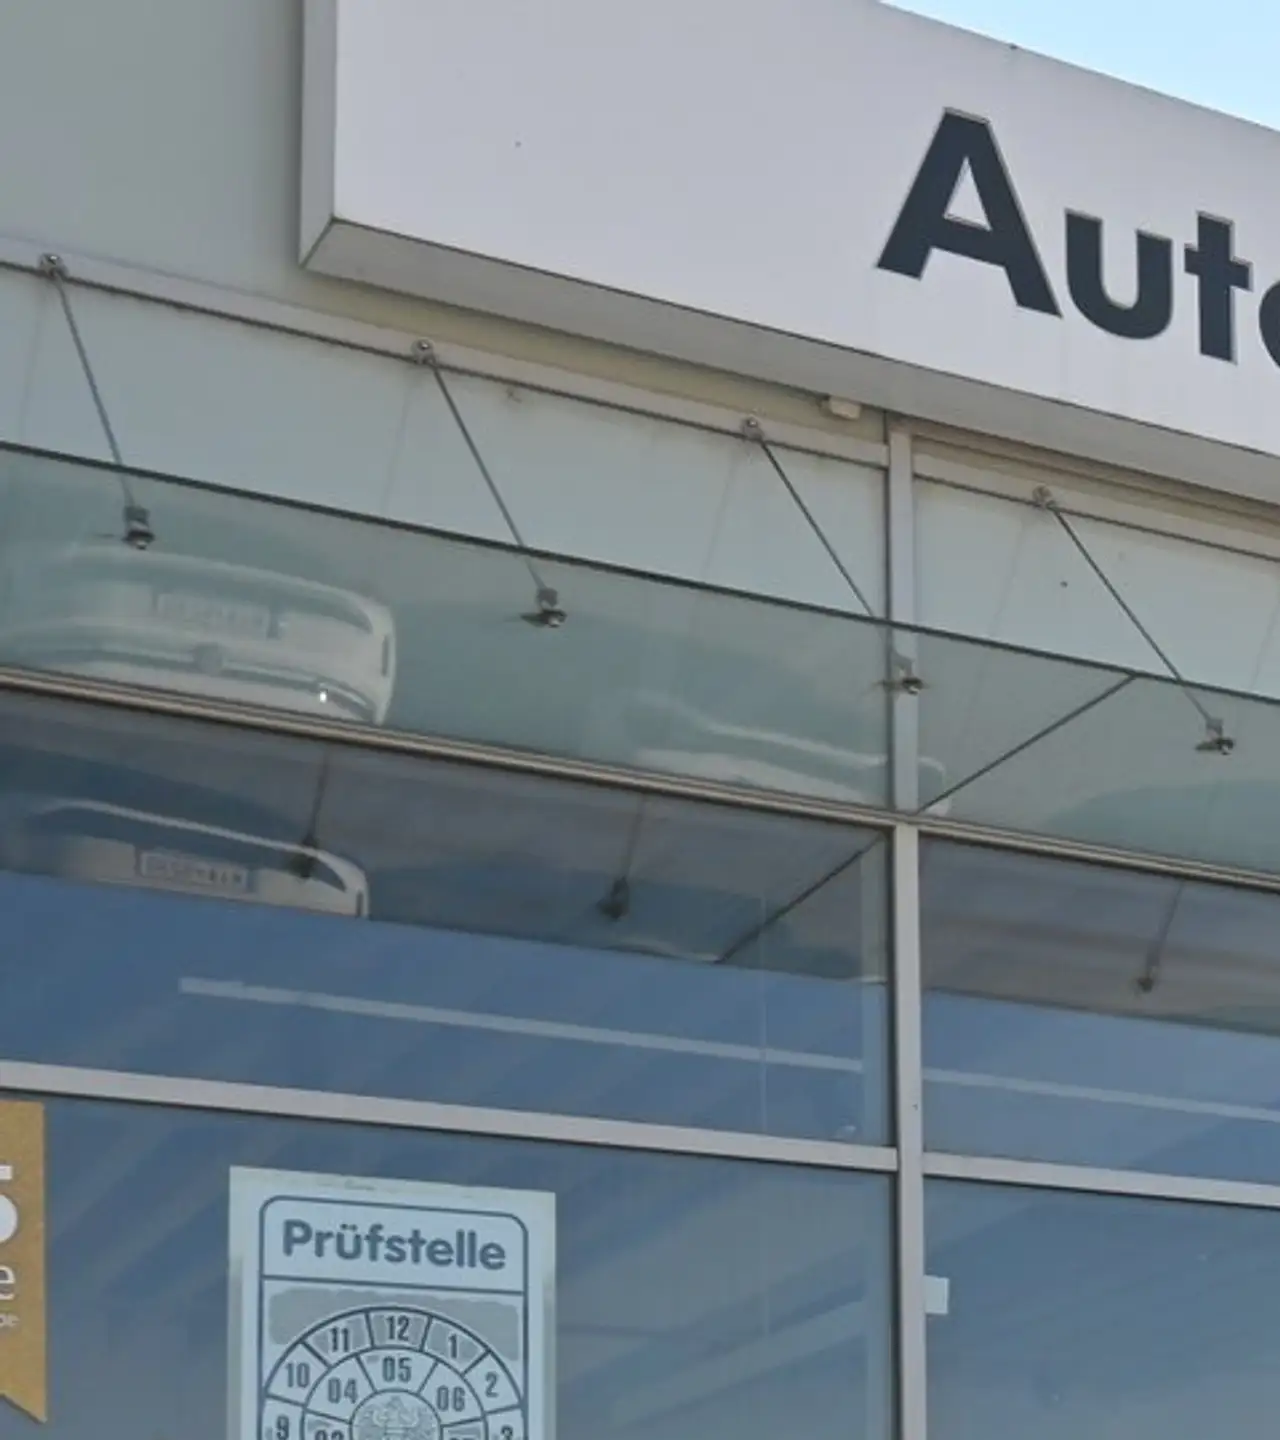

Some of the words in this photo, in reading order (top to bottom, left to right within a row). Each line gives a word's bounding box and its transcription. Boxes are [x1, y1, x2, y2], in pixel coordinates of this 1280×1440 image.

[281, 1218, 507, 1271] Prüfstelle
[331, 1327, 349, 1352] 11
[386, 1315, 409, 1342] 12
[448, 1333, 458, 1358] 1
[286, 1362, 310, 1389] 10
[382, 1356, 412, 1383] 05
[327, 1378, 359, 1404] 04
[485, 1372, 498, 1398] 2
[436, 1385, 466, 1412] 06
[276, 1415, 290, 1440] 9
